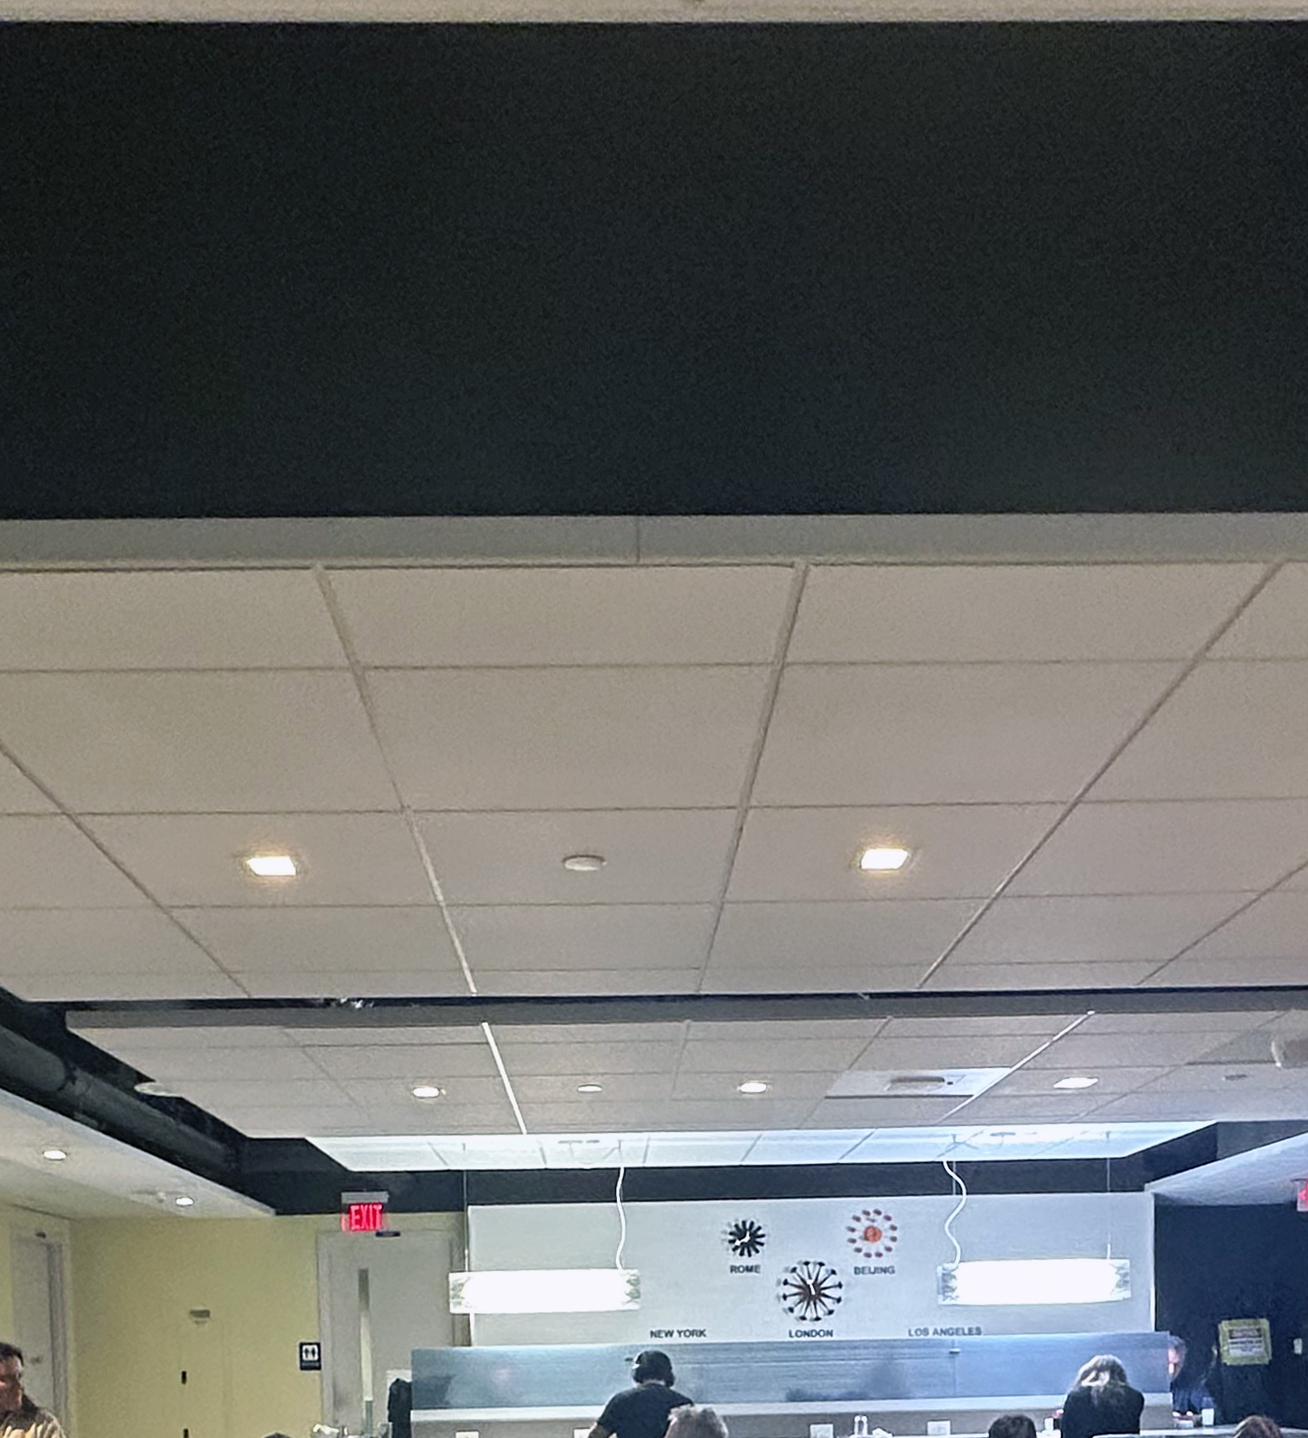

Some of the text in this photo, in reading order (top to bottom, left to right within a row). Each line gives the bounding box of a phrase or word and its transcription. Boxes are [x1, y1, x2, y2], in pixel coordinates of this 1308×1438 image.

[350, 1204, 382, 1230] EXIT
[730, 1264, 761, 1274] ROME
[853, 1265, 895, 1276] BEIJING
[650, 1328, 707, 1339] NEW YORK
[788, 1328, 834, 1338] LONDON
[908, 1326, 982, 1337] LOS ANGELES
